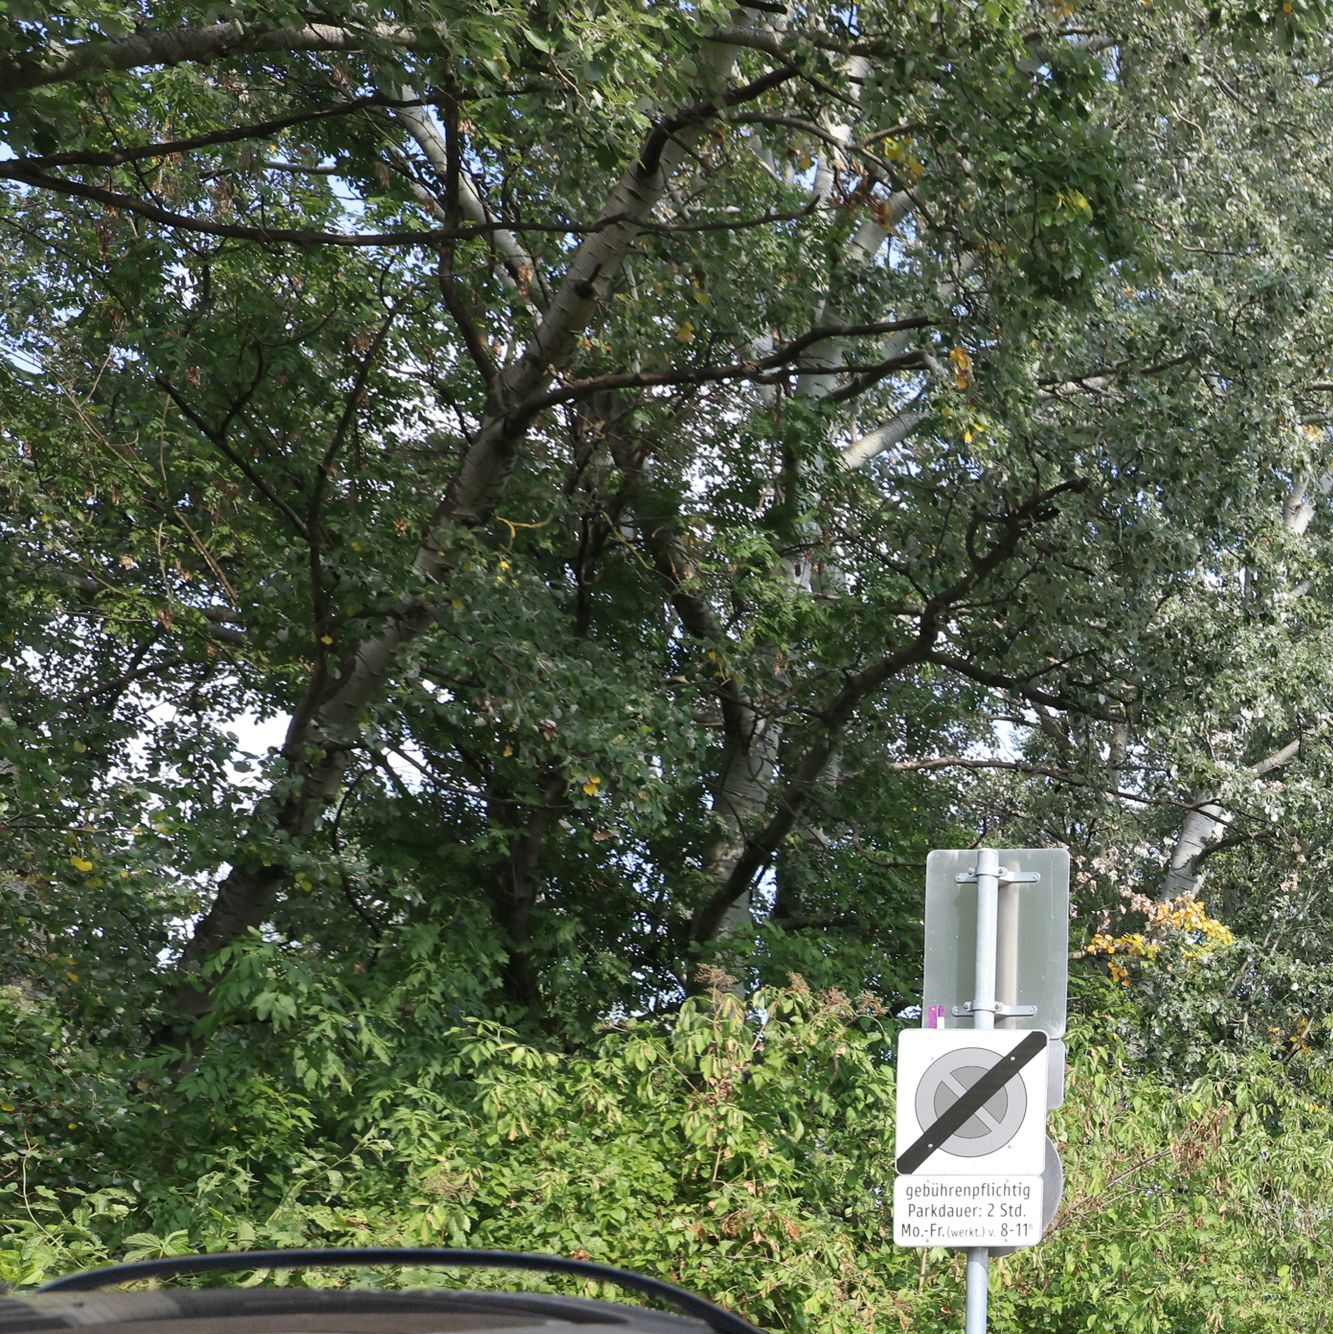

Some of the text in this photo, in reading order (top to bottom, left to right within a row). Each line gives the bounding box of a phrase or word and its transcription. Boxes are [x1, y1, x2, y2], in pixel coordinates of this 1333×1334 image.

[905, 1181, 1031, 1201] gebührenpflichtig
[907, 1202, 1026, 1218] Parkdauer: 2 Std.
